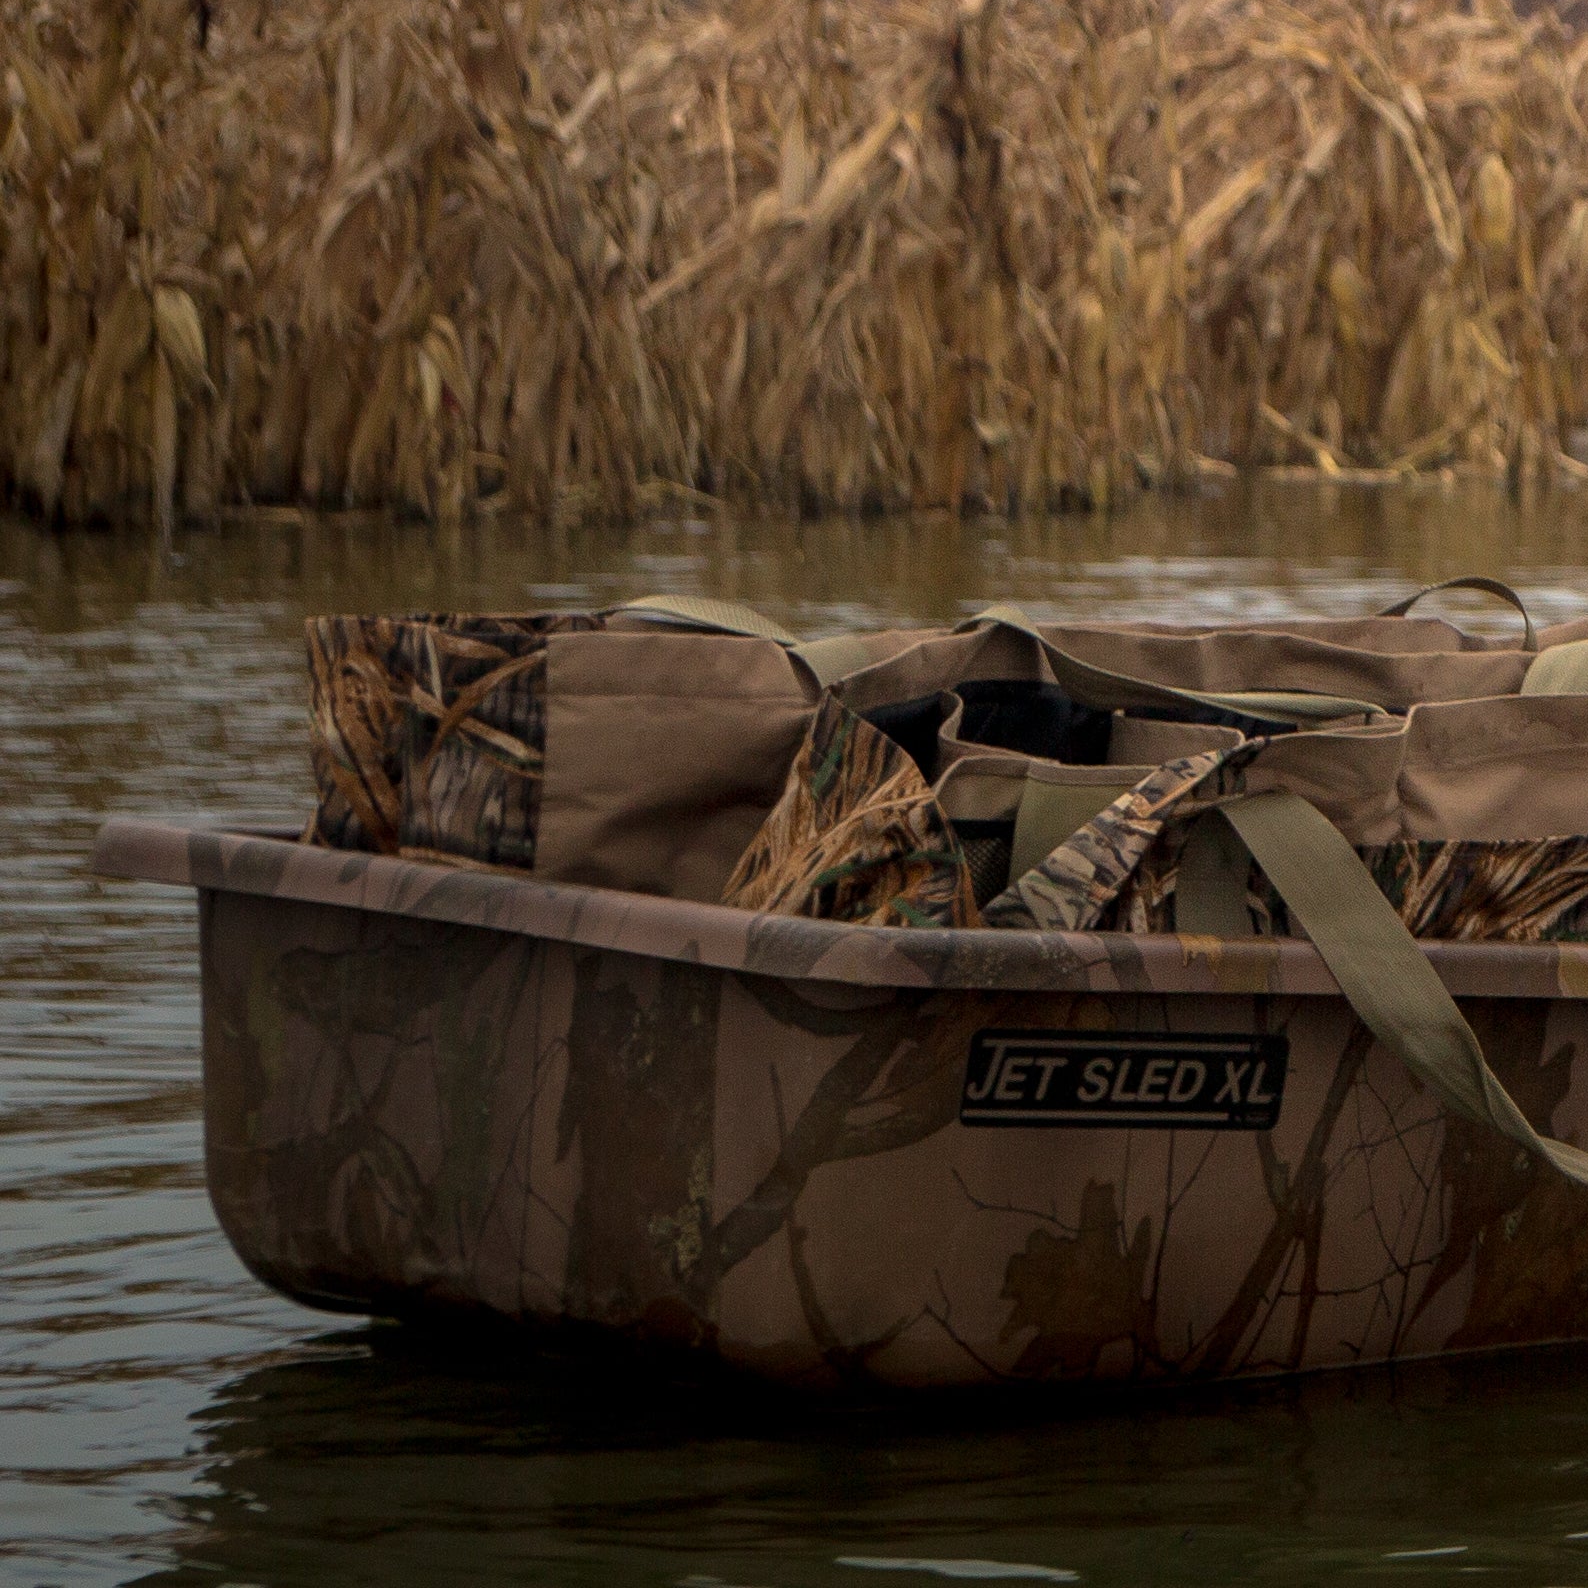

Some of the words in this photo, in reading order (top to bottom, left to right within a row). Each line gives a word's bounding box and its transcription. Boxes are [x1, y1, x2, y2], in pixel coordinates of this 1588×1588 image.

[966, 1040, 1068, 1101] JET
[1077, 1057, 1207, 1103] SLED
[1214, 1061, 1277, 1104] XL
